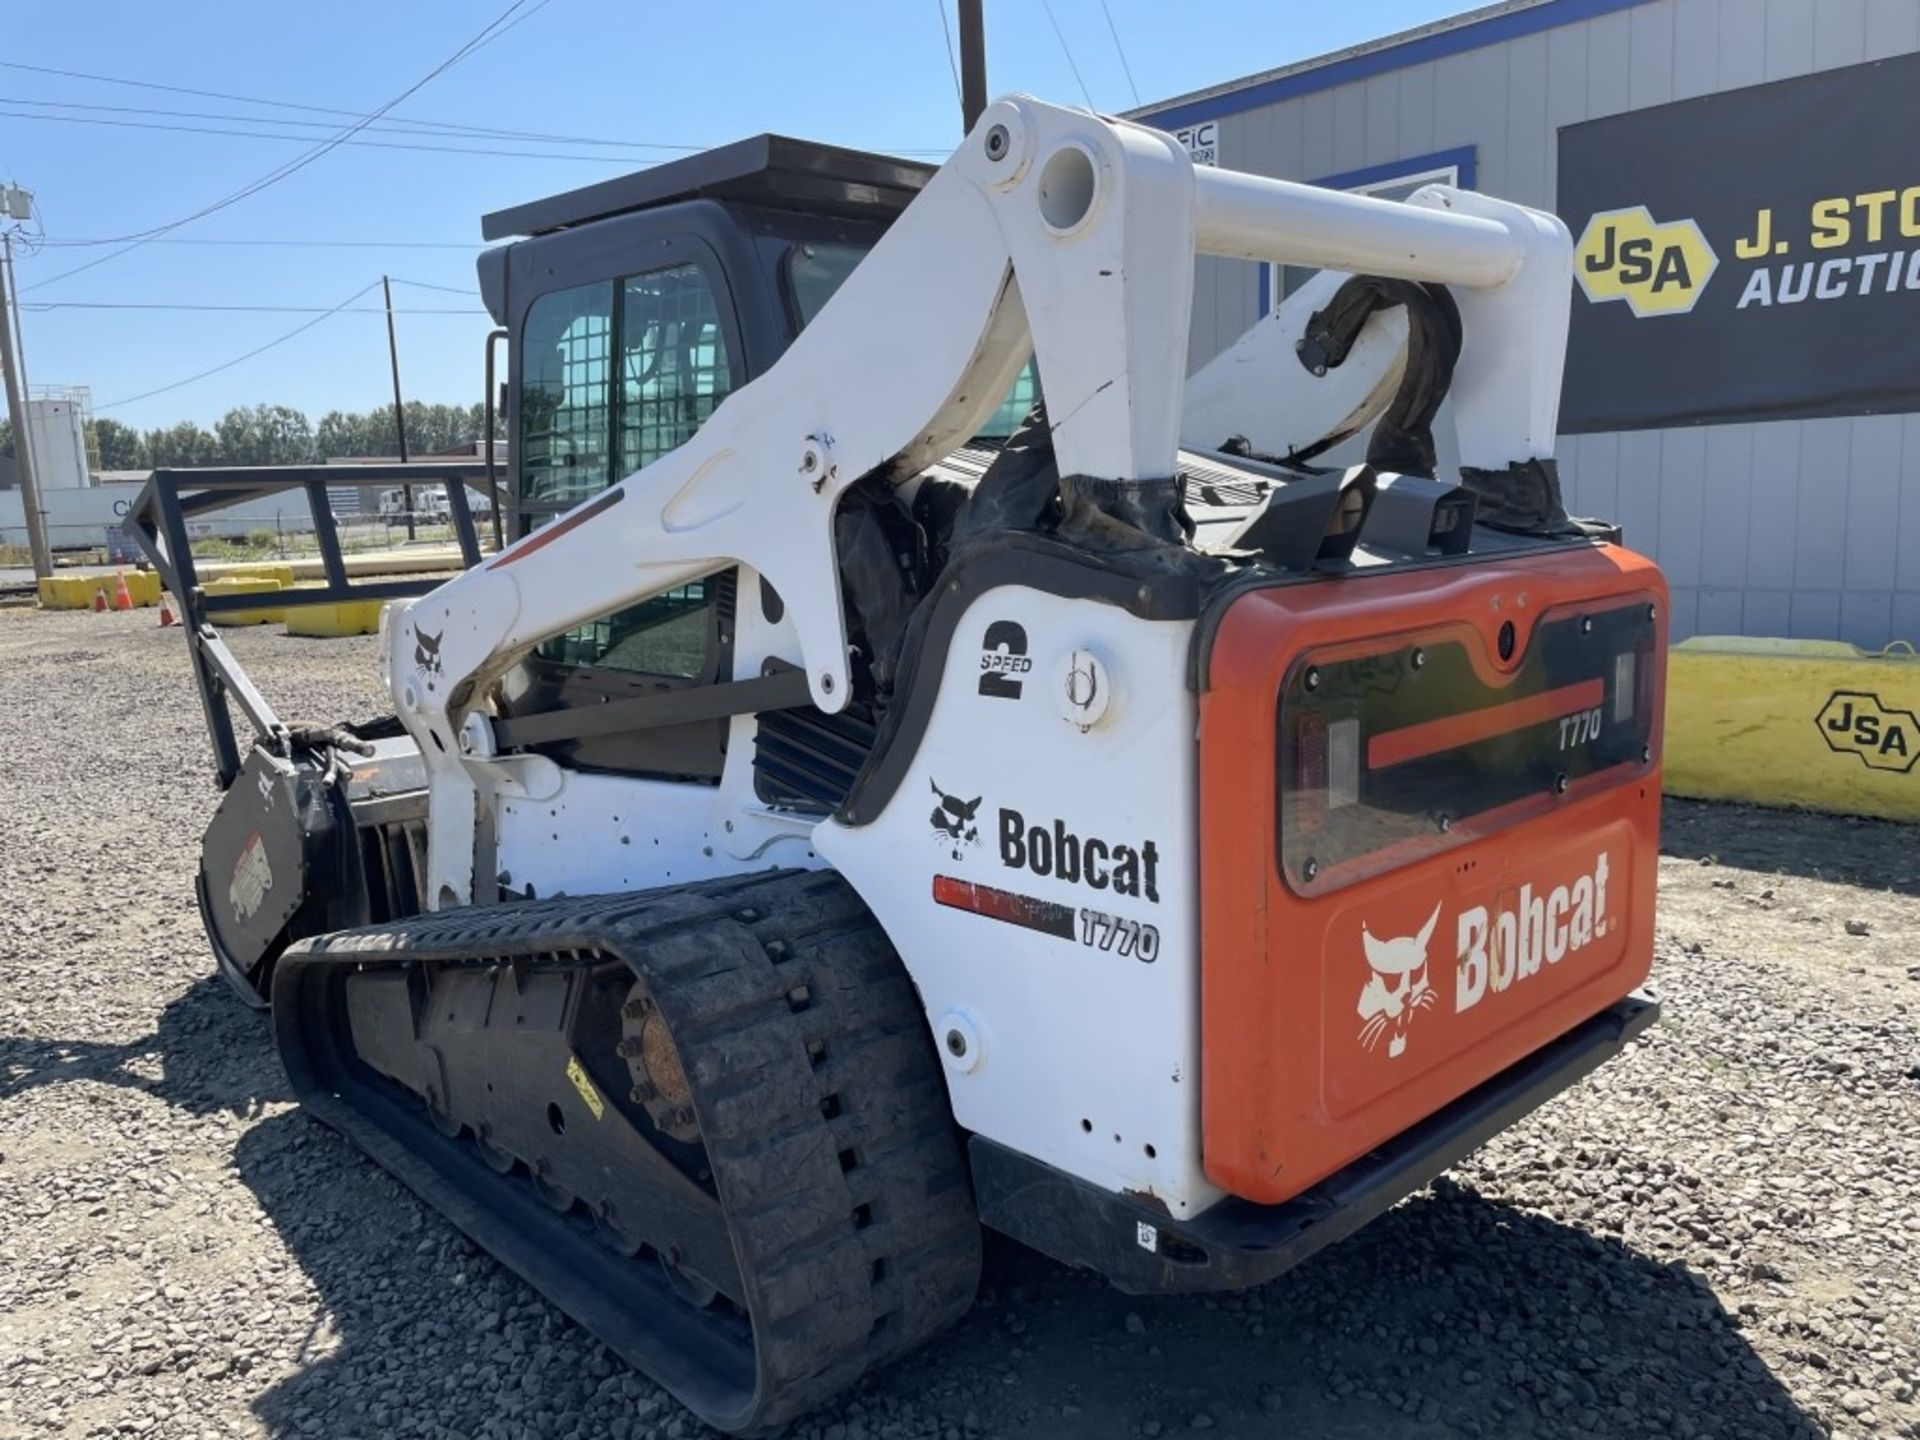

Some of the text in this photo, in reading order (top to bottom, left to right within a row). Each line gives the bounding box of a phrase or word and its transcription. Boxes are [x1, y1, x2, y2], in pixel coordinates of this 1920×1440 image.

[1586, 226, 1692, 293] JSA
[1735, 208, 1788, 259] J.
[979, 620, 1033, 700] 2 SPEED
[1559, 708, 1602, 751] T770
[1828, 703, 1907, 756] JSA
[999, 808, 1159, 904] Bobcat
[1080, 907, 1160, 963] T770
[1456, 851, 1609, 1014] Bobcat
